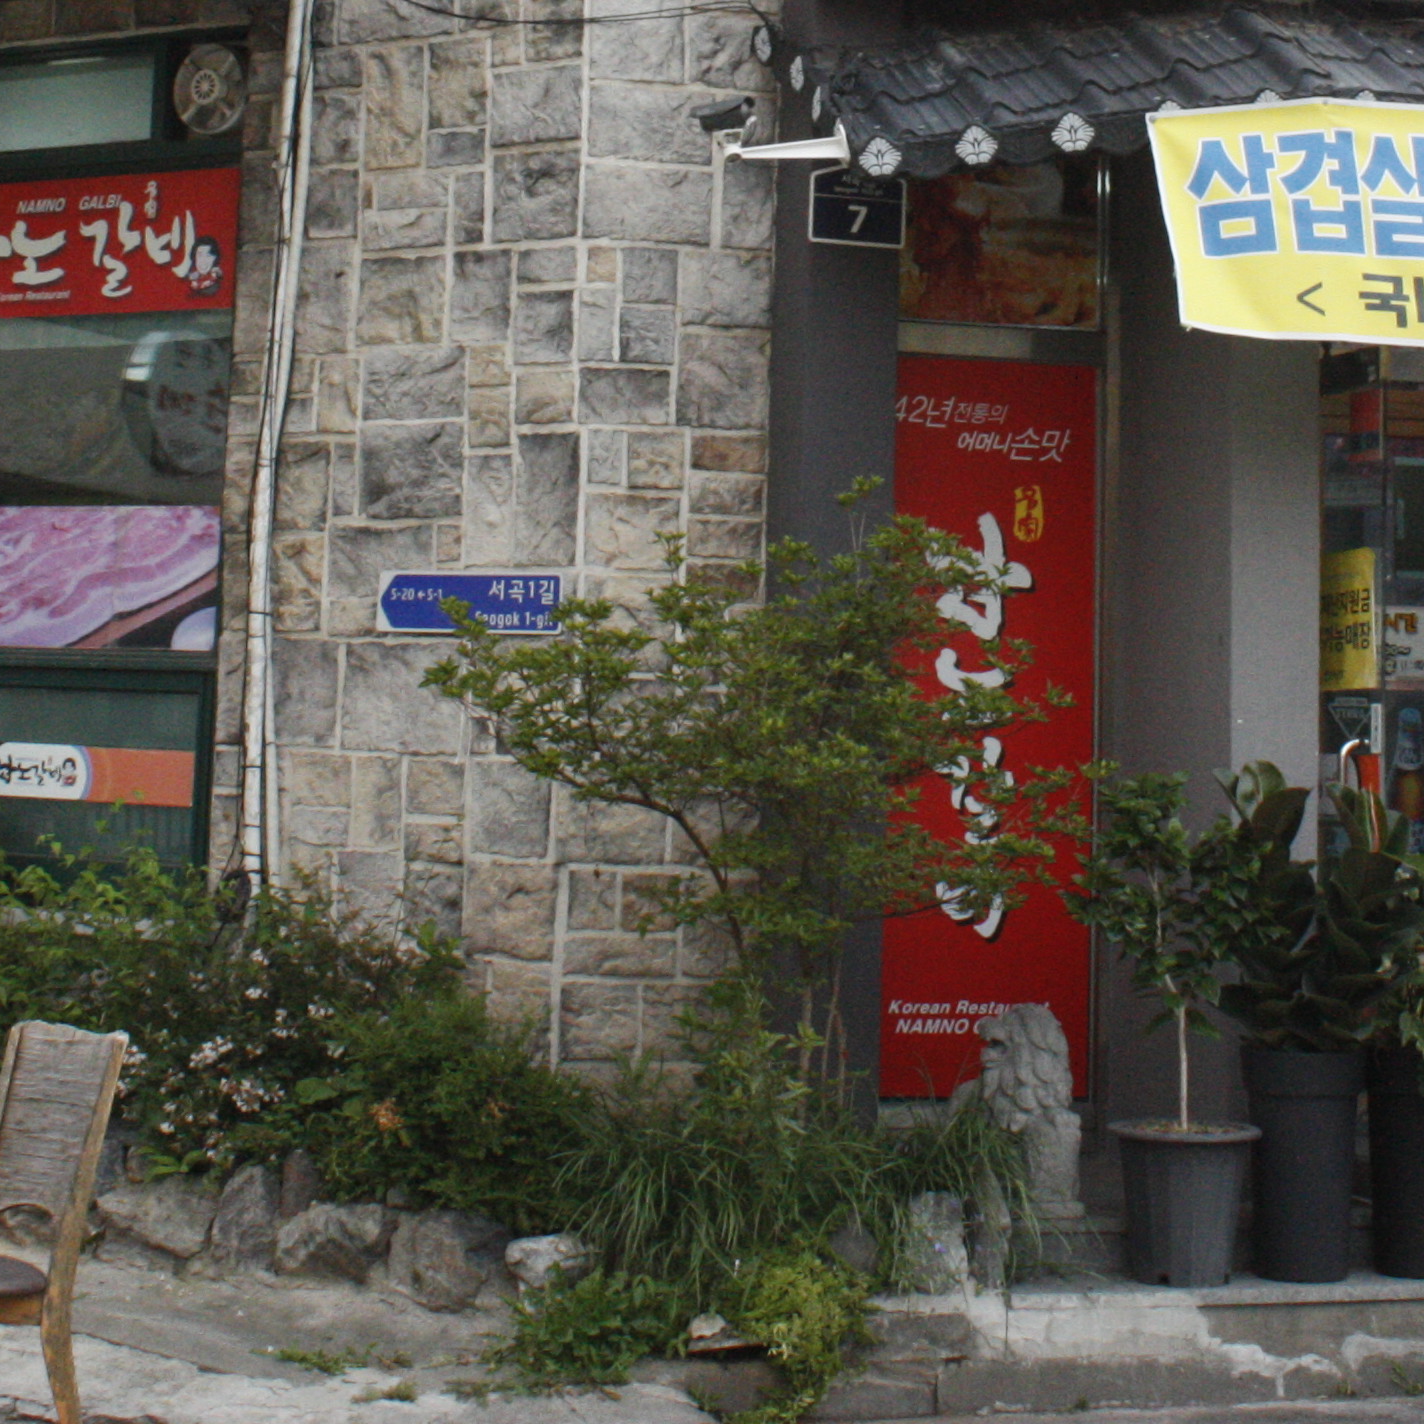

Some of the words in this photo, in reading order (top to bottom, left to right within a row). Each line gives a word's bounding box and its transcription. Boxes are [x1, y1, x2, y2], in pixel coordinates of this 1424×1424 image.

[16, 197, 66, 215] NAMNO
[79, 194, 122, 211] GALBI
[848, 204, 867, 233] 7
[25, 289, 71, 300] Restaurant
[957, 427, 1071, 463] 어머니손맛
[489, 579, 555, 605] 서곡1길
[888, 1000, 951, 1015] Korean
[895, 1019, 969, 1035] NAMNO
